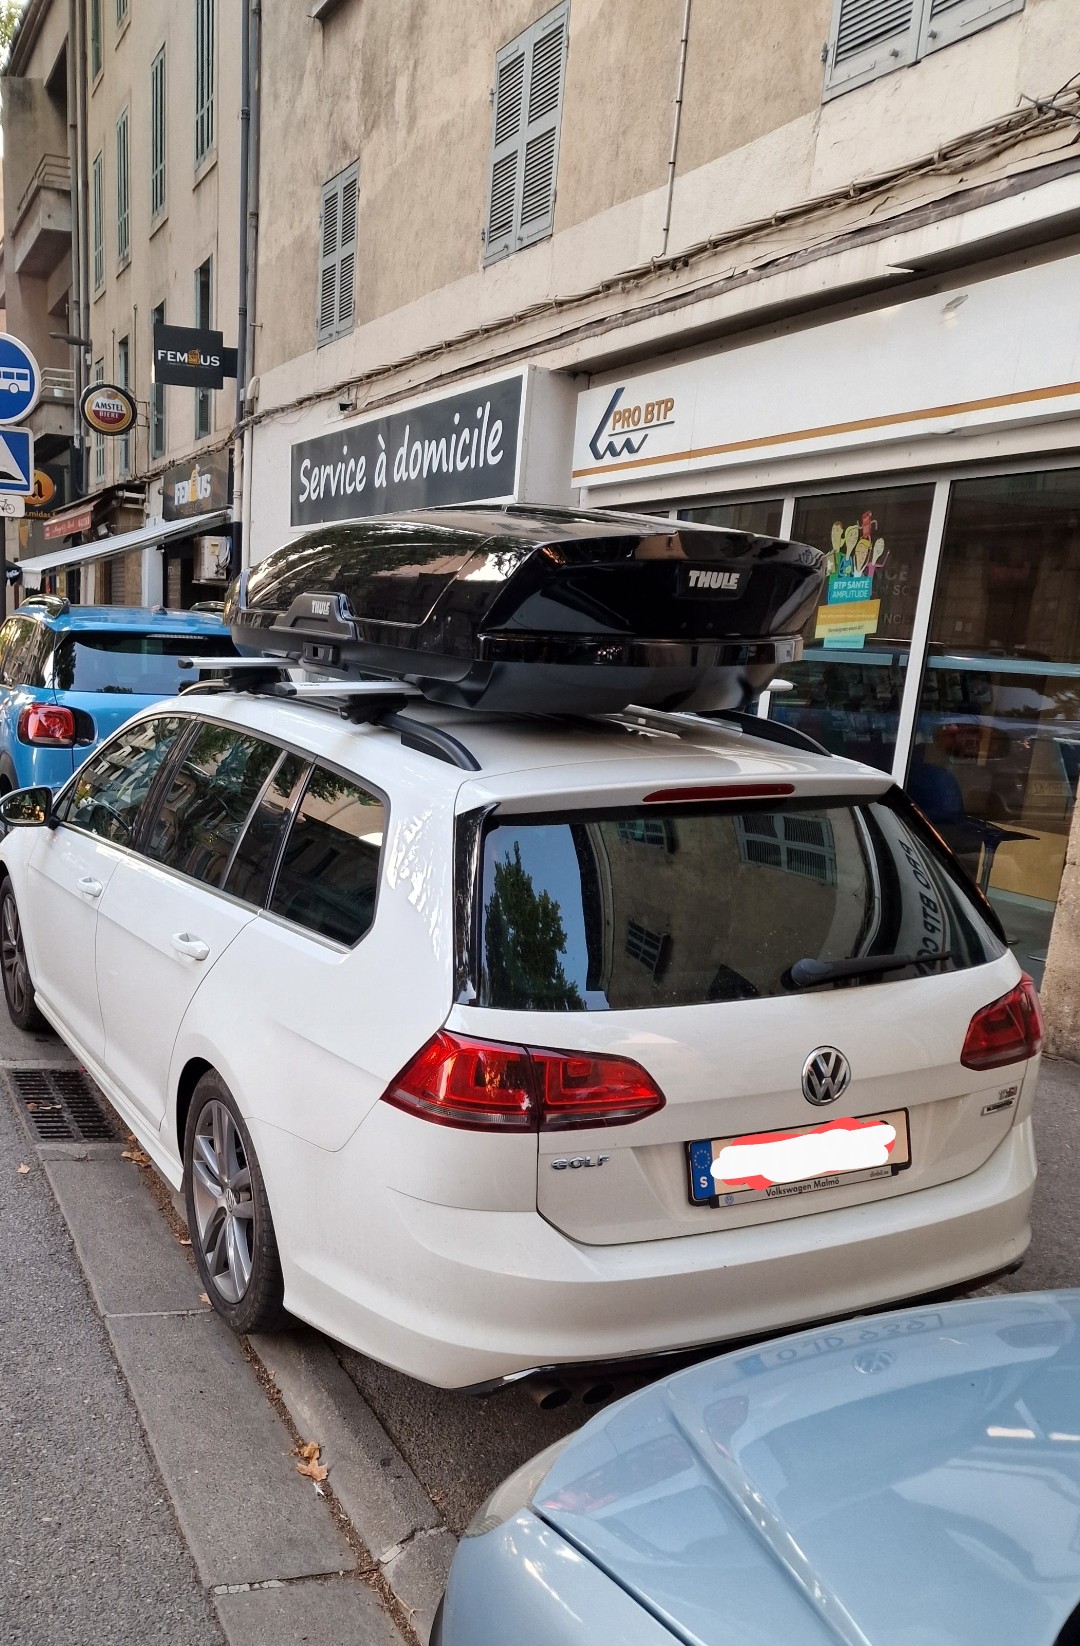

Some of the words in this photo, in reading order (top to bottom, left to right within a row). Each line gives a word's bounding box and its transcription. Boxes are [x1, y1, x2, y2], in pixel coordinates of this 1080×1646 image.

[95, 401, 124, 411] AMSTEL
[612, 405, 642, 431] PRO
[643, 397, 675, 424] BTP
[299, 444, 367, 503] Service
[374, 433, 387, 488] à
[393, 400, 504, 483] domicile
[688, 570, 741, 590] THULE
[833, 581, 847, 590] BTP
[847, 578, 870, 589] SANTÉ
[832, 589, 869, 599] AMPLITUDE
[311, 600, 331, 615] THULE
[551, 1154, 610, 1170] GOLF
[699, 1176, 709, 1188] S
[765, 1183, 812, 1197] Volkswagen
[813, 1176, 840, 1191] Malmö
